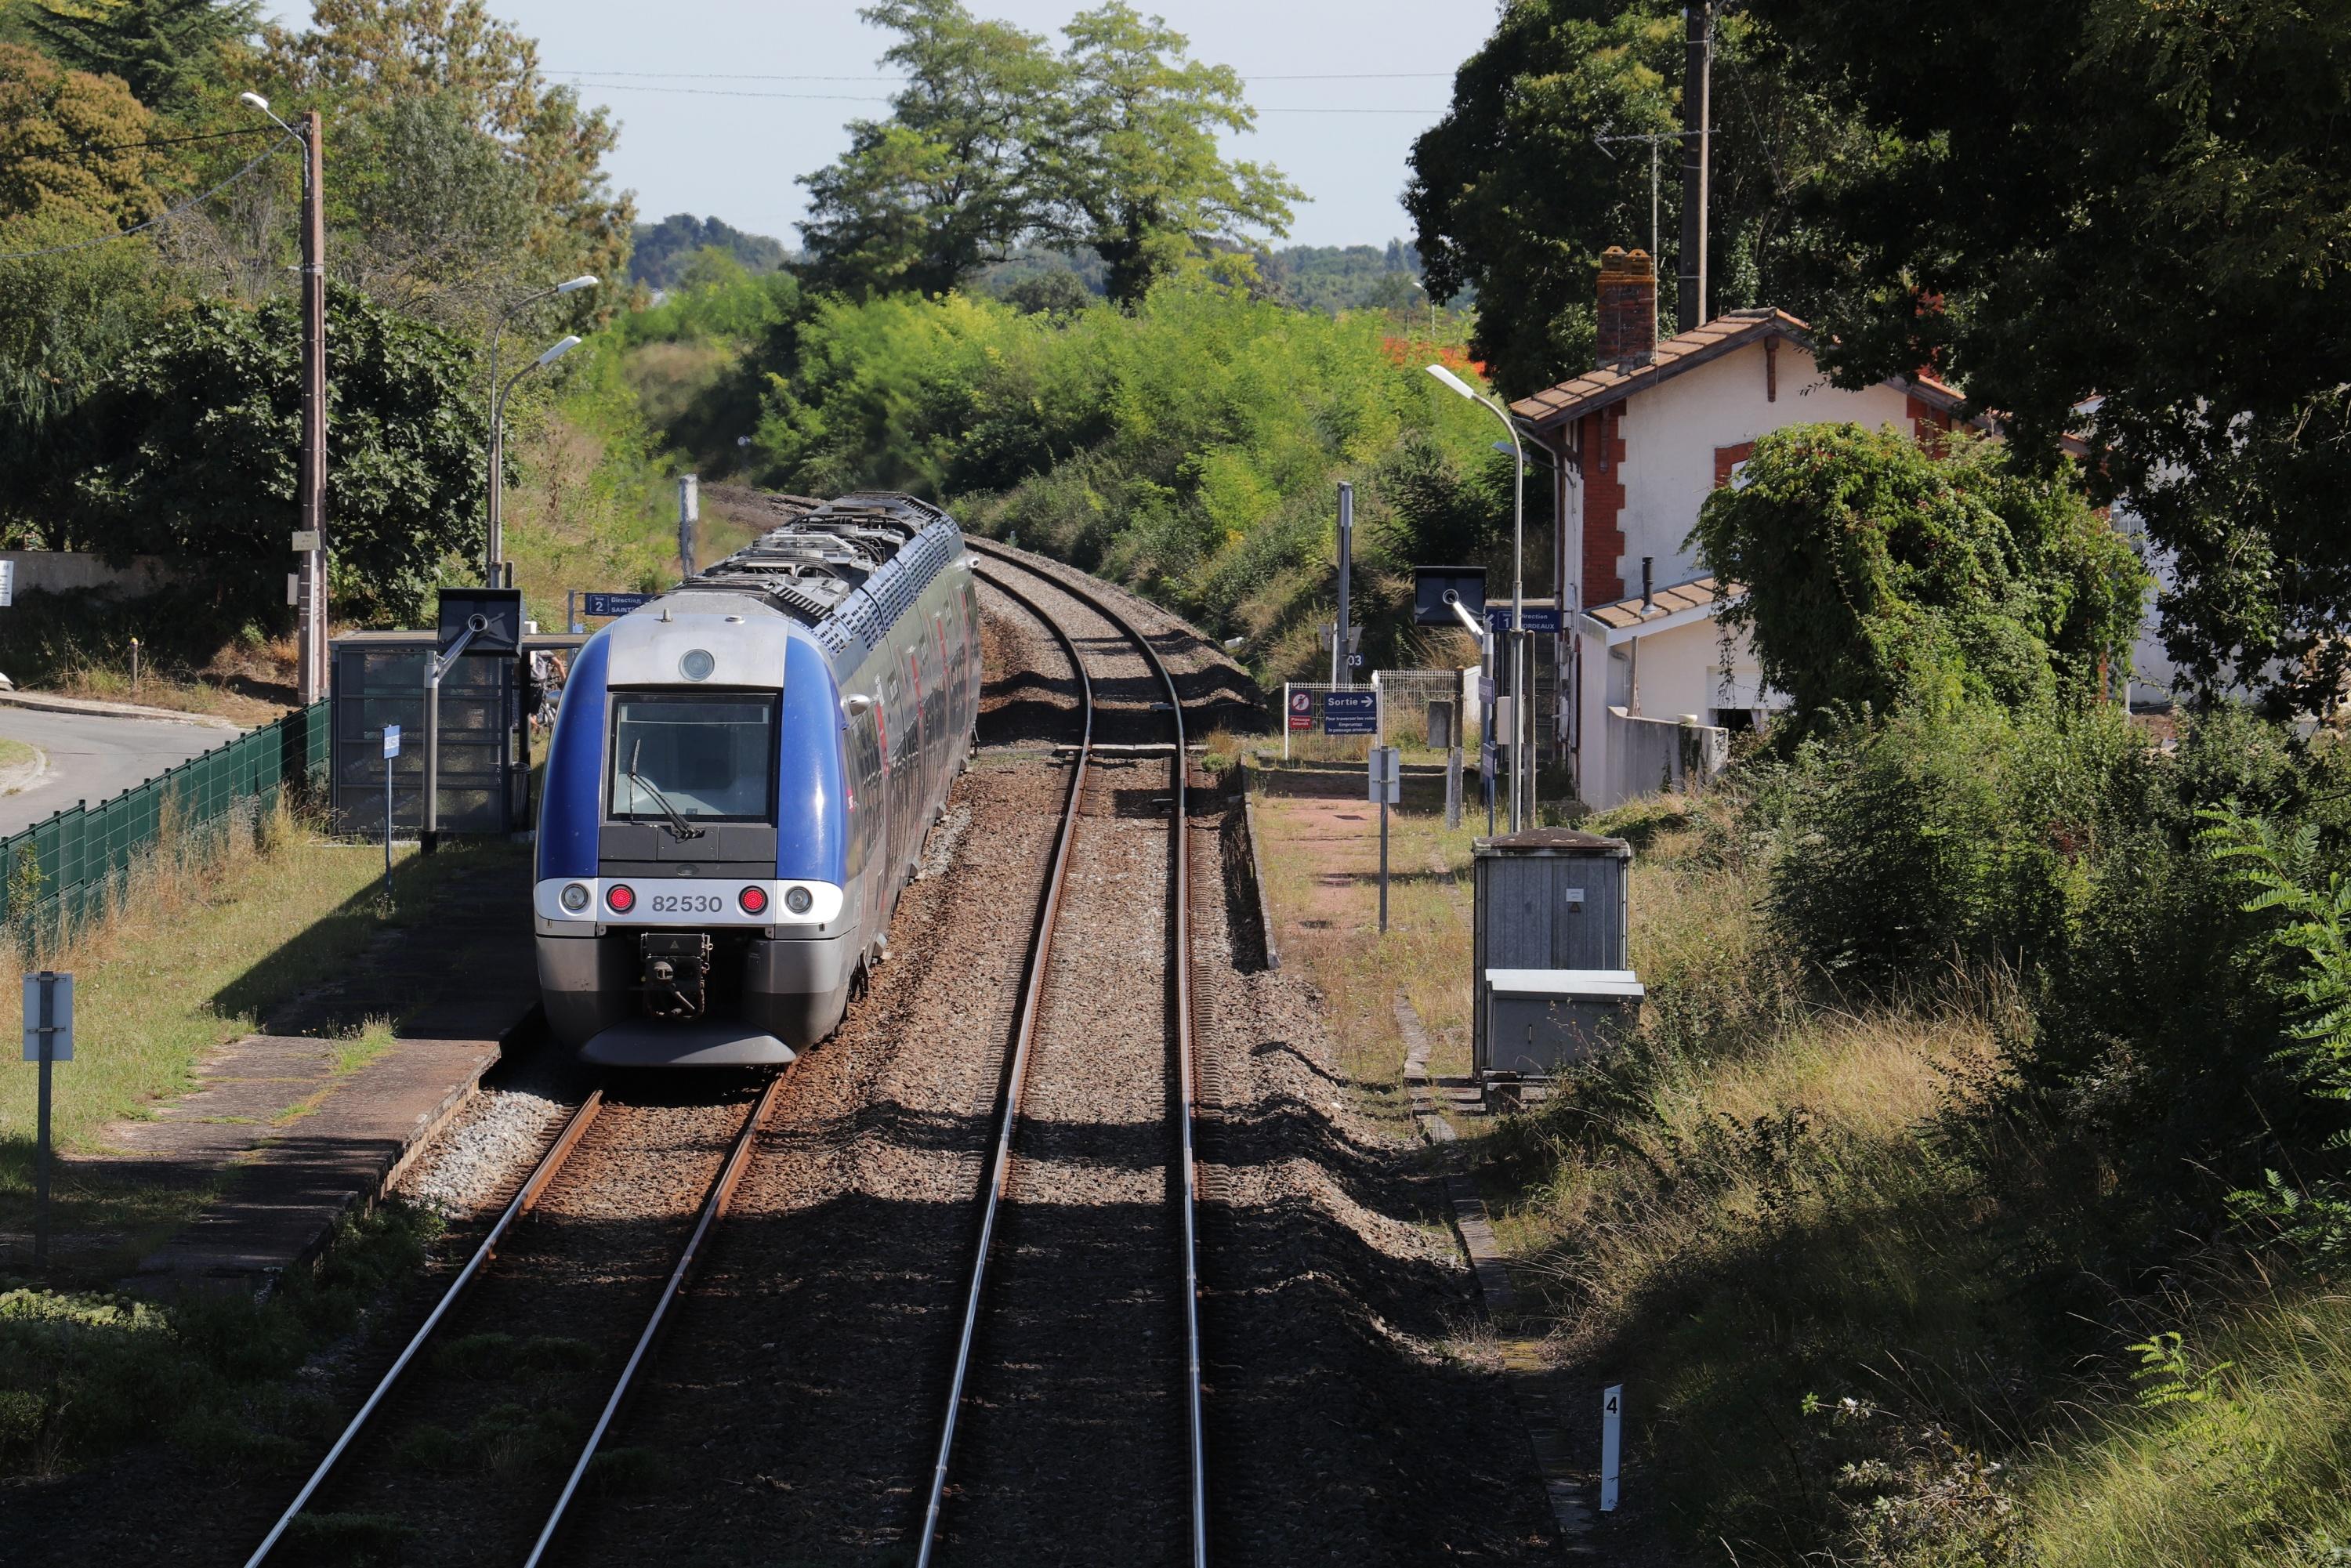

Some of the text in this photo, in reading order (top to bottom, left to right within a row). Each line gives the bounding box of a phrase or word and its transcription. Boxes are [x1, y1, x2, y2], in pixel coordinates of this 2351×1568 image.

[596, 601, 603, 611] 2
[1504, 617, 1509, 628] 1
[1328, 697, 1358, 706] Sortie
[652, 896, 723, 912] 82530
[1607, 1396, 1617, 1414] 4
